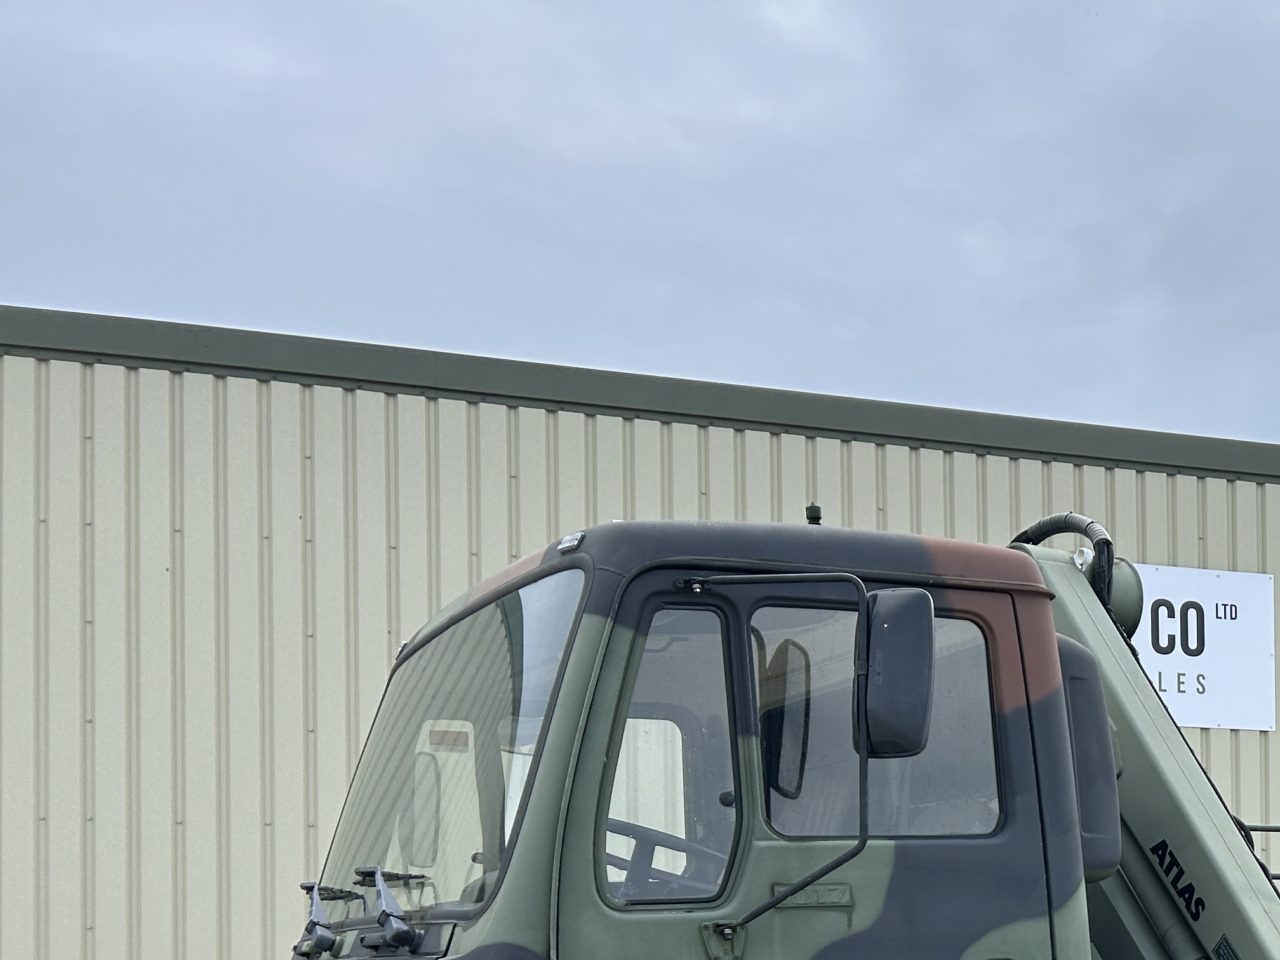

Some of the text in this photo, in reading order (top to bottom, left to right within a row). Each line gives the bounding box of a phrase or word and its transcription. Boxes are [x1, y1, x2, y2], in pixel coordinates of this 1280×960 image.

[1150, 598, 1238, 657] CO LTD
[1158, 671, 1206, 695] LES
[1149, 839, 1206, 922] ATLAS
